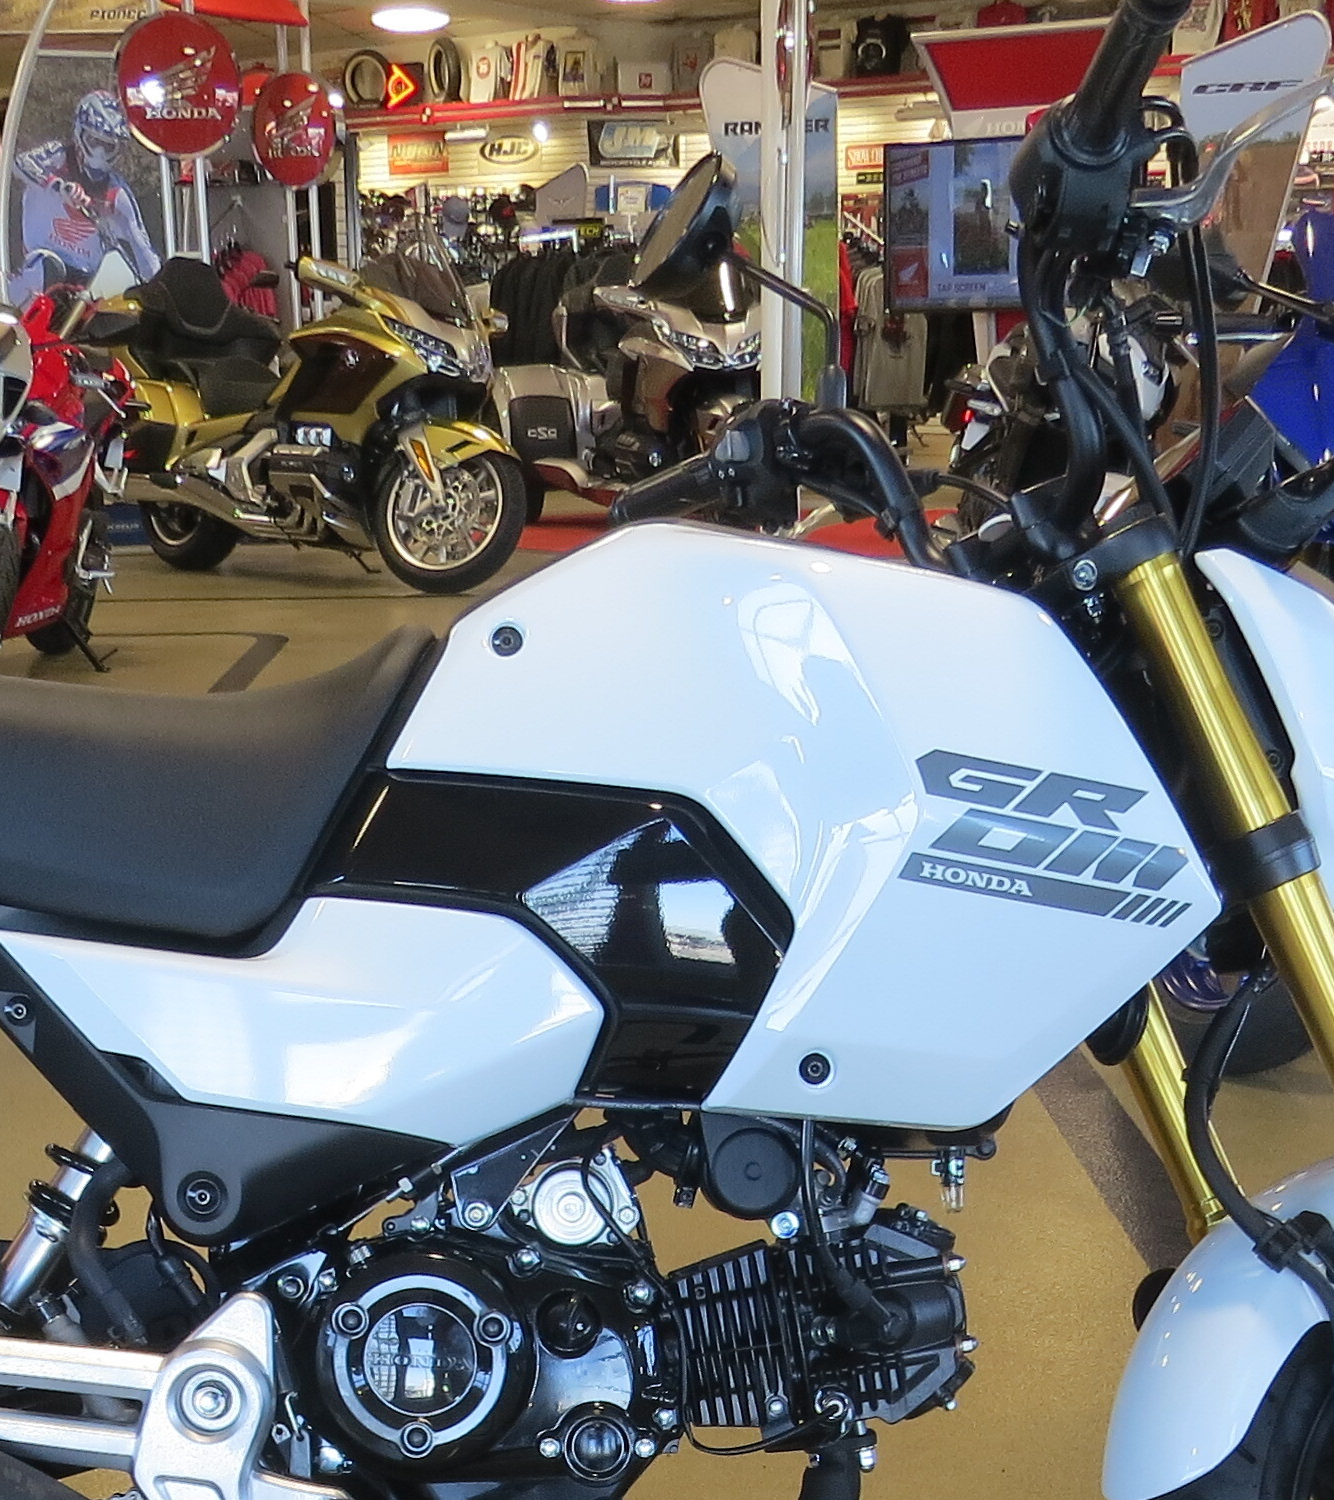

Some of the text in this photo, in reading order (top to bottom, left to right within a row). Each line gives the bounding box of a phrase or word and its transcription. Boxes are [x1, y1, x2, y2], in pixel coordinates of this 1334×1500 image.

[144, 106, 222, 120] HONDA
[489, 141, 529, 157] HJC
[14, 605, 63, 629] HONDA
[919, 860, 1034, 898] HONDA
[370, 1352, 472, 1371] HONDA
